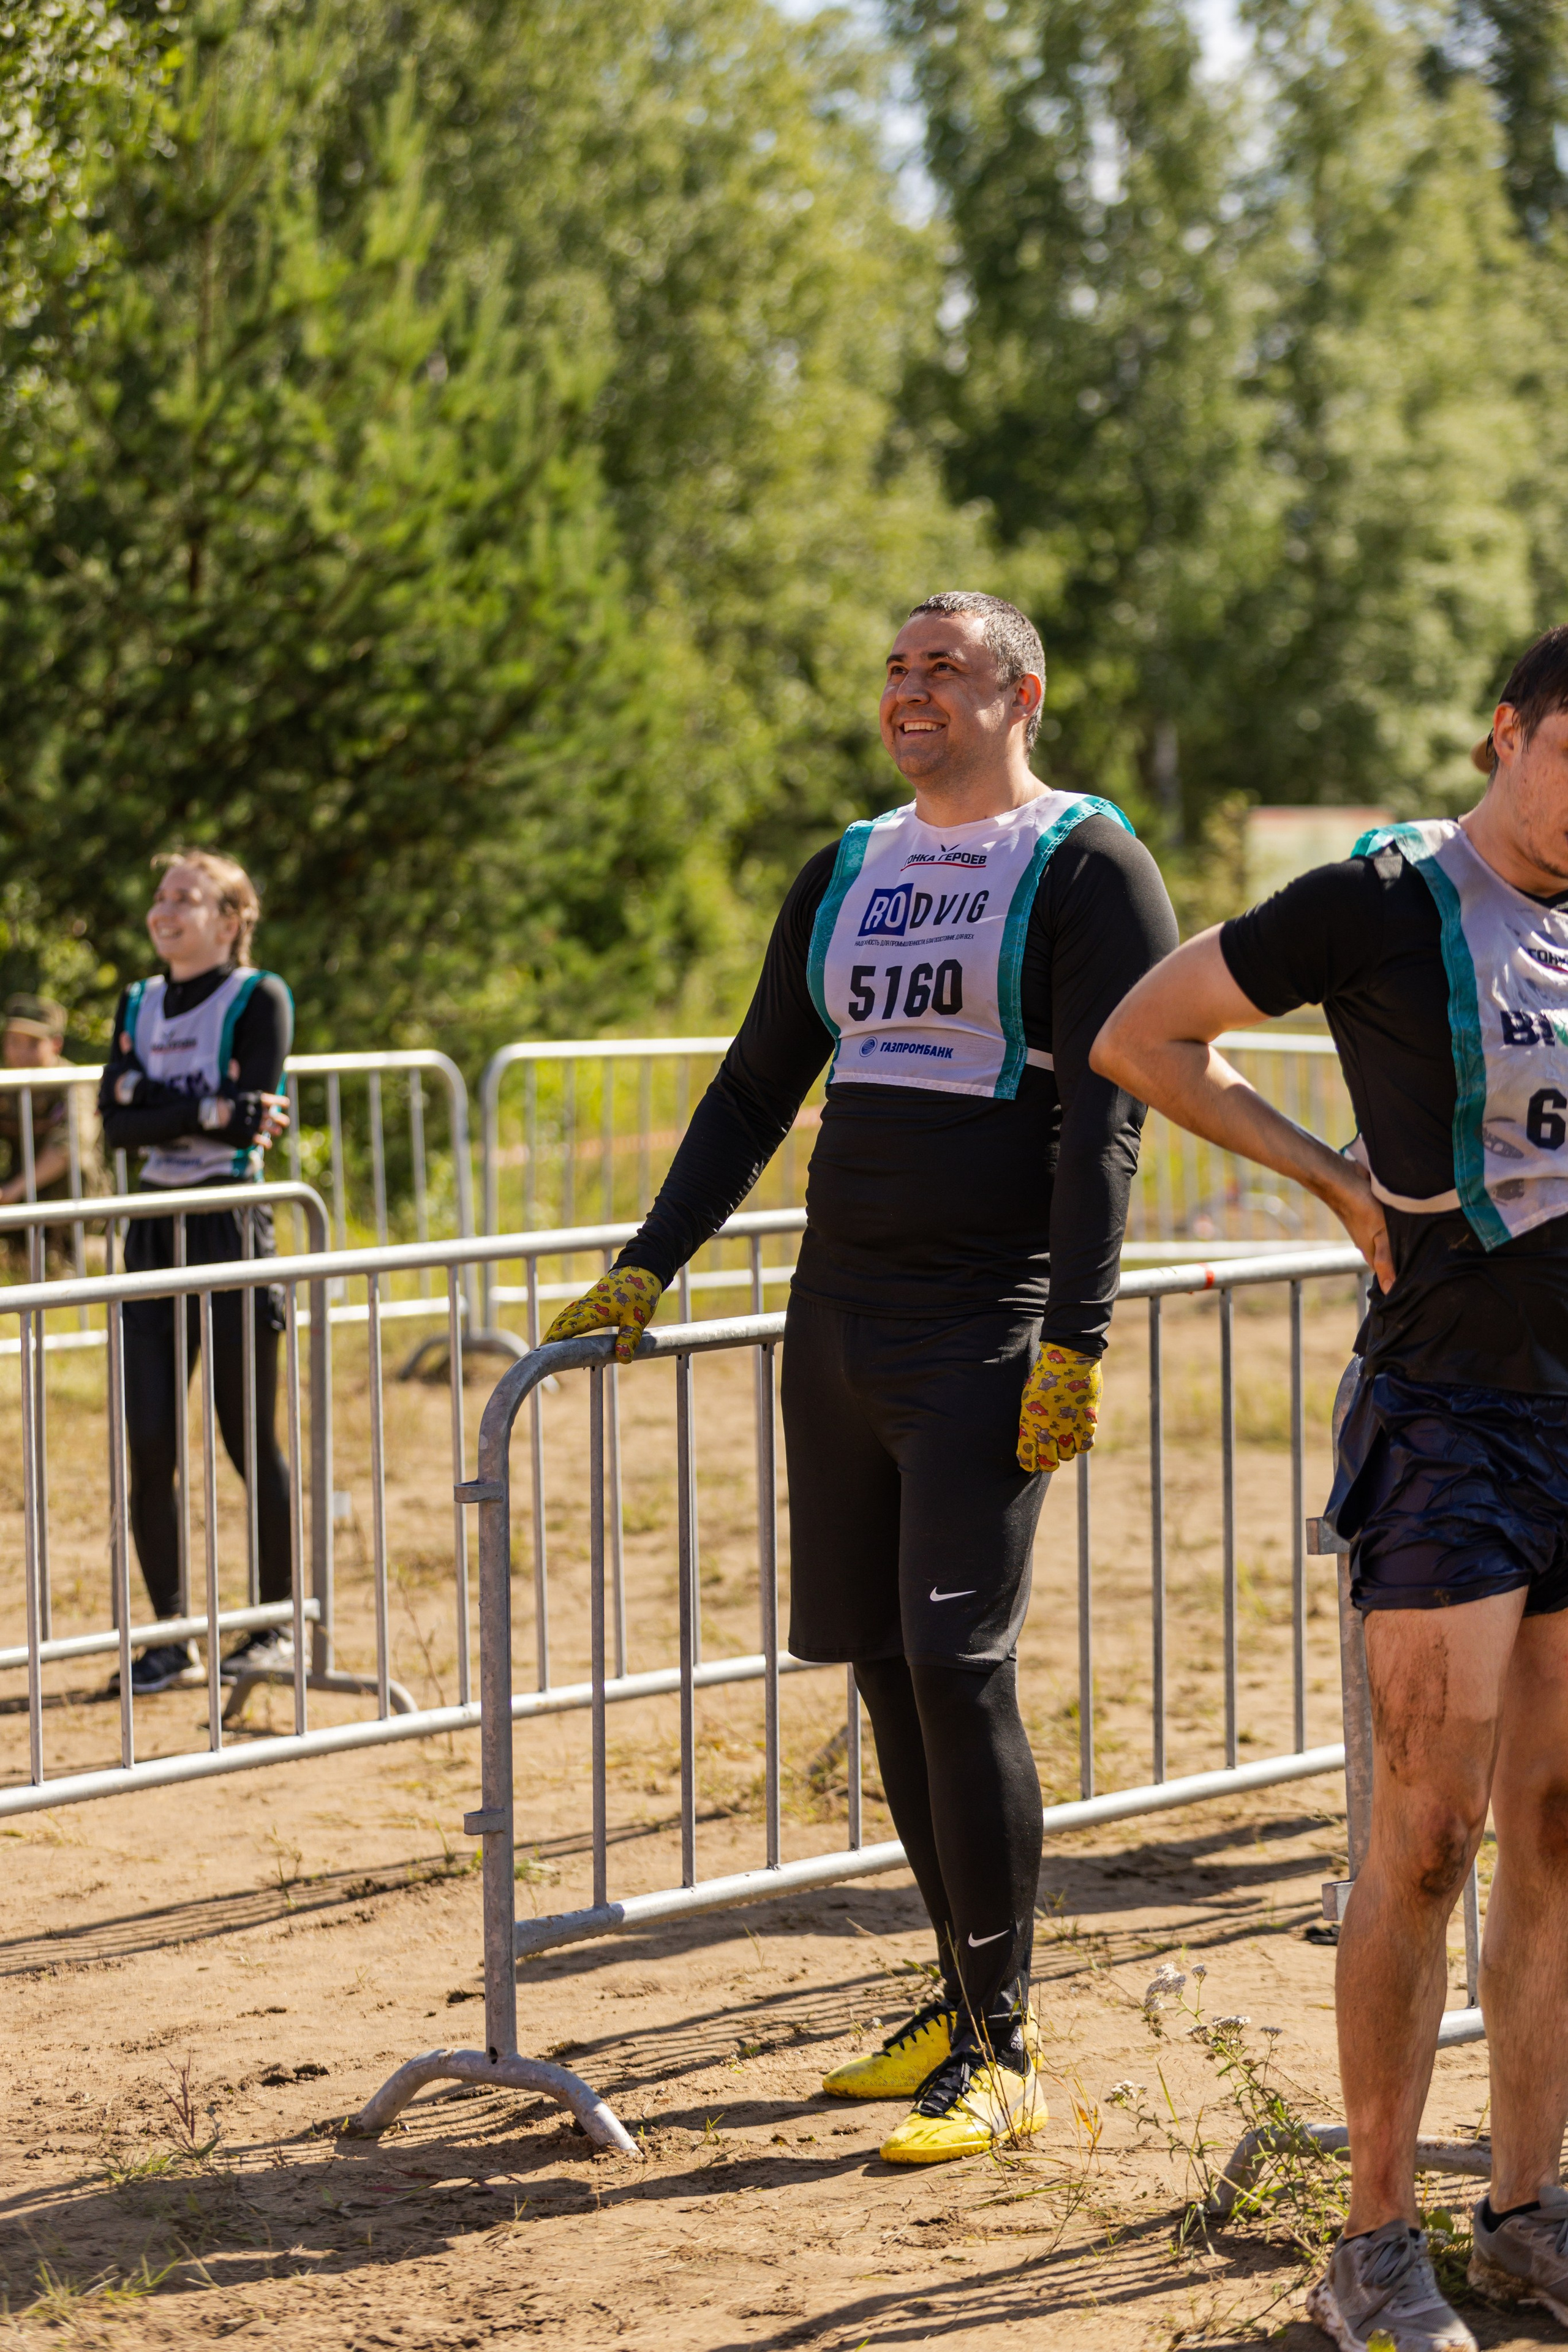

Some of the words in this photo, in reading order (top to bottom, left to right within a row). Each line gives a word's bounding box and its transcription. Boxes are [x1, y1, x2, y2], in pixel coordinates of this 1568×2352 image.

[938, 852, 987, 865] ГЕРОЕВ
[864, 890, 989, 929] RODVIG
[848, 959, 963, 1021] 5160
[880, 1042, 954, 1058] ГАЗПРОМБАНК
